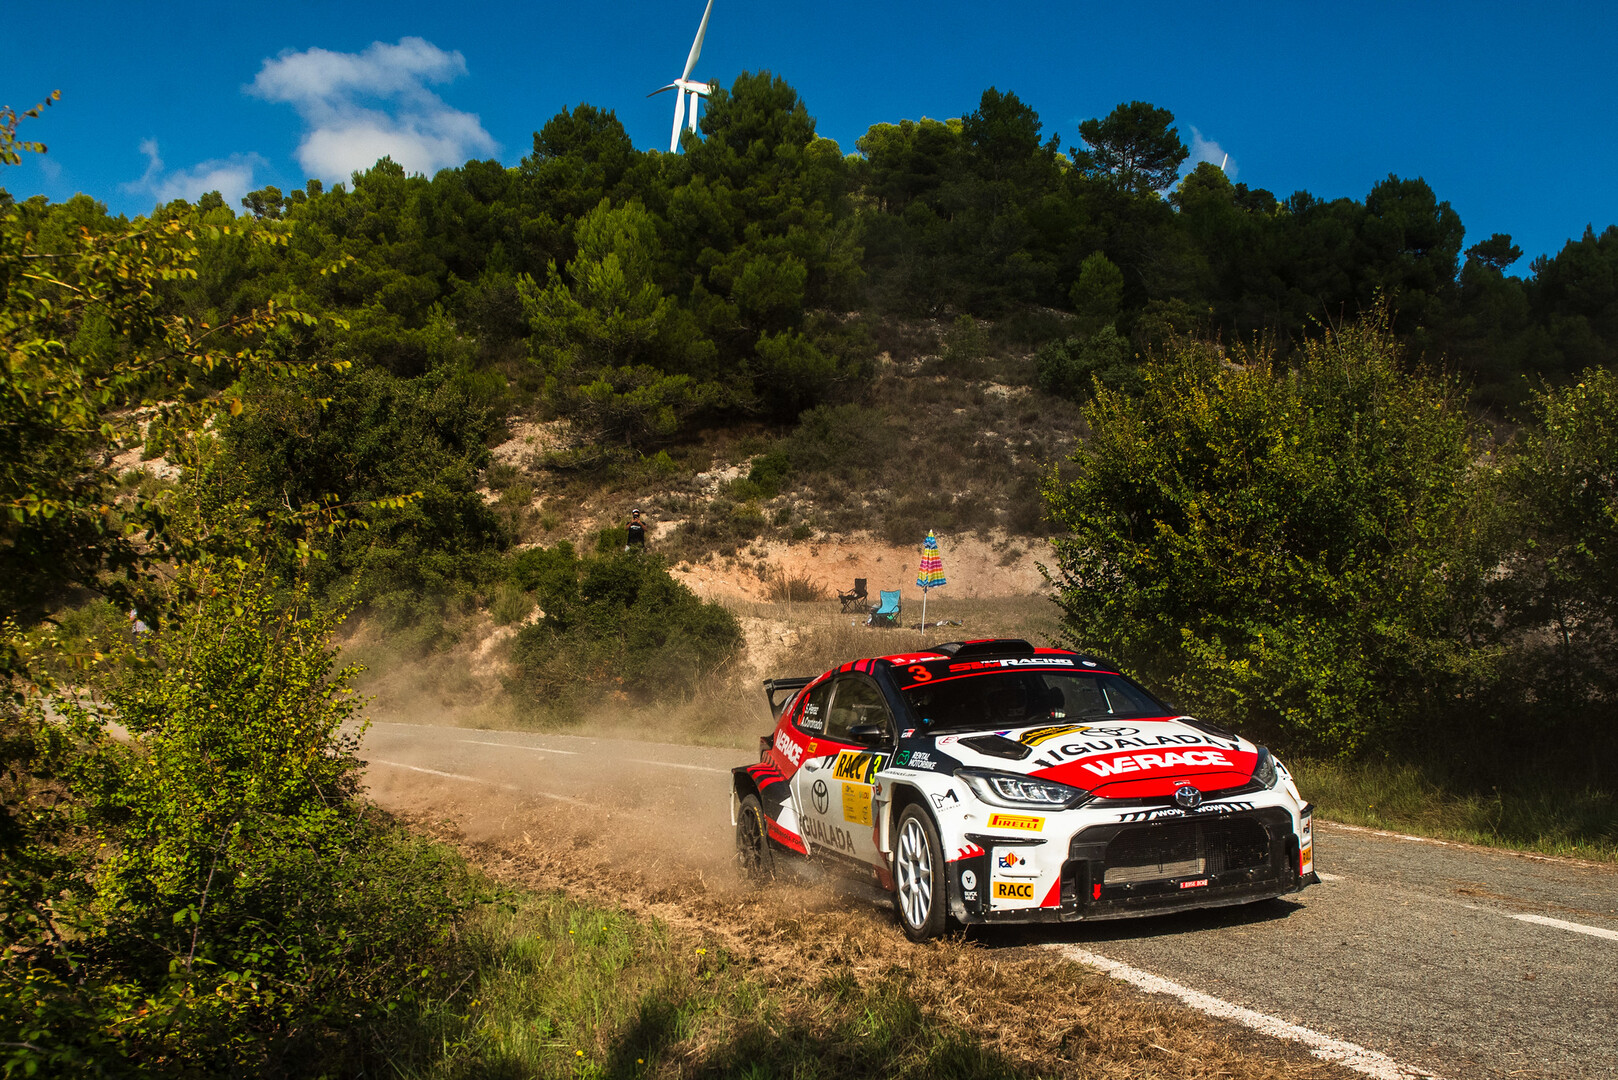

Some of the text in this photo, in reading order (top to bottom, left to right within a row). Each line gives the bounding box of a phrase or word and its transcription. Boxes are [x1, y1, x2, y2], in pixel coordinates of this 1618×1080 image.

[907, 665, 933, 682] 3
[1000, 658, 1075, 667] RACING
[775, 728, 803, 767] WERACE
[1047, 732, 1227, 762] IGUALADA
[836, 754, 868, 780] RACC
[869, 755, 882, 785] 3
[1081, 750, 1234, 777] WERACE
[992, 815, 1040, 830] PIRELLI
[999, 884, 1032, 898] RACC
